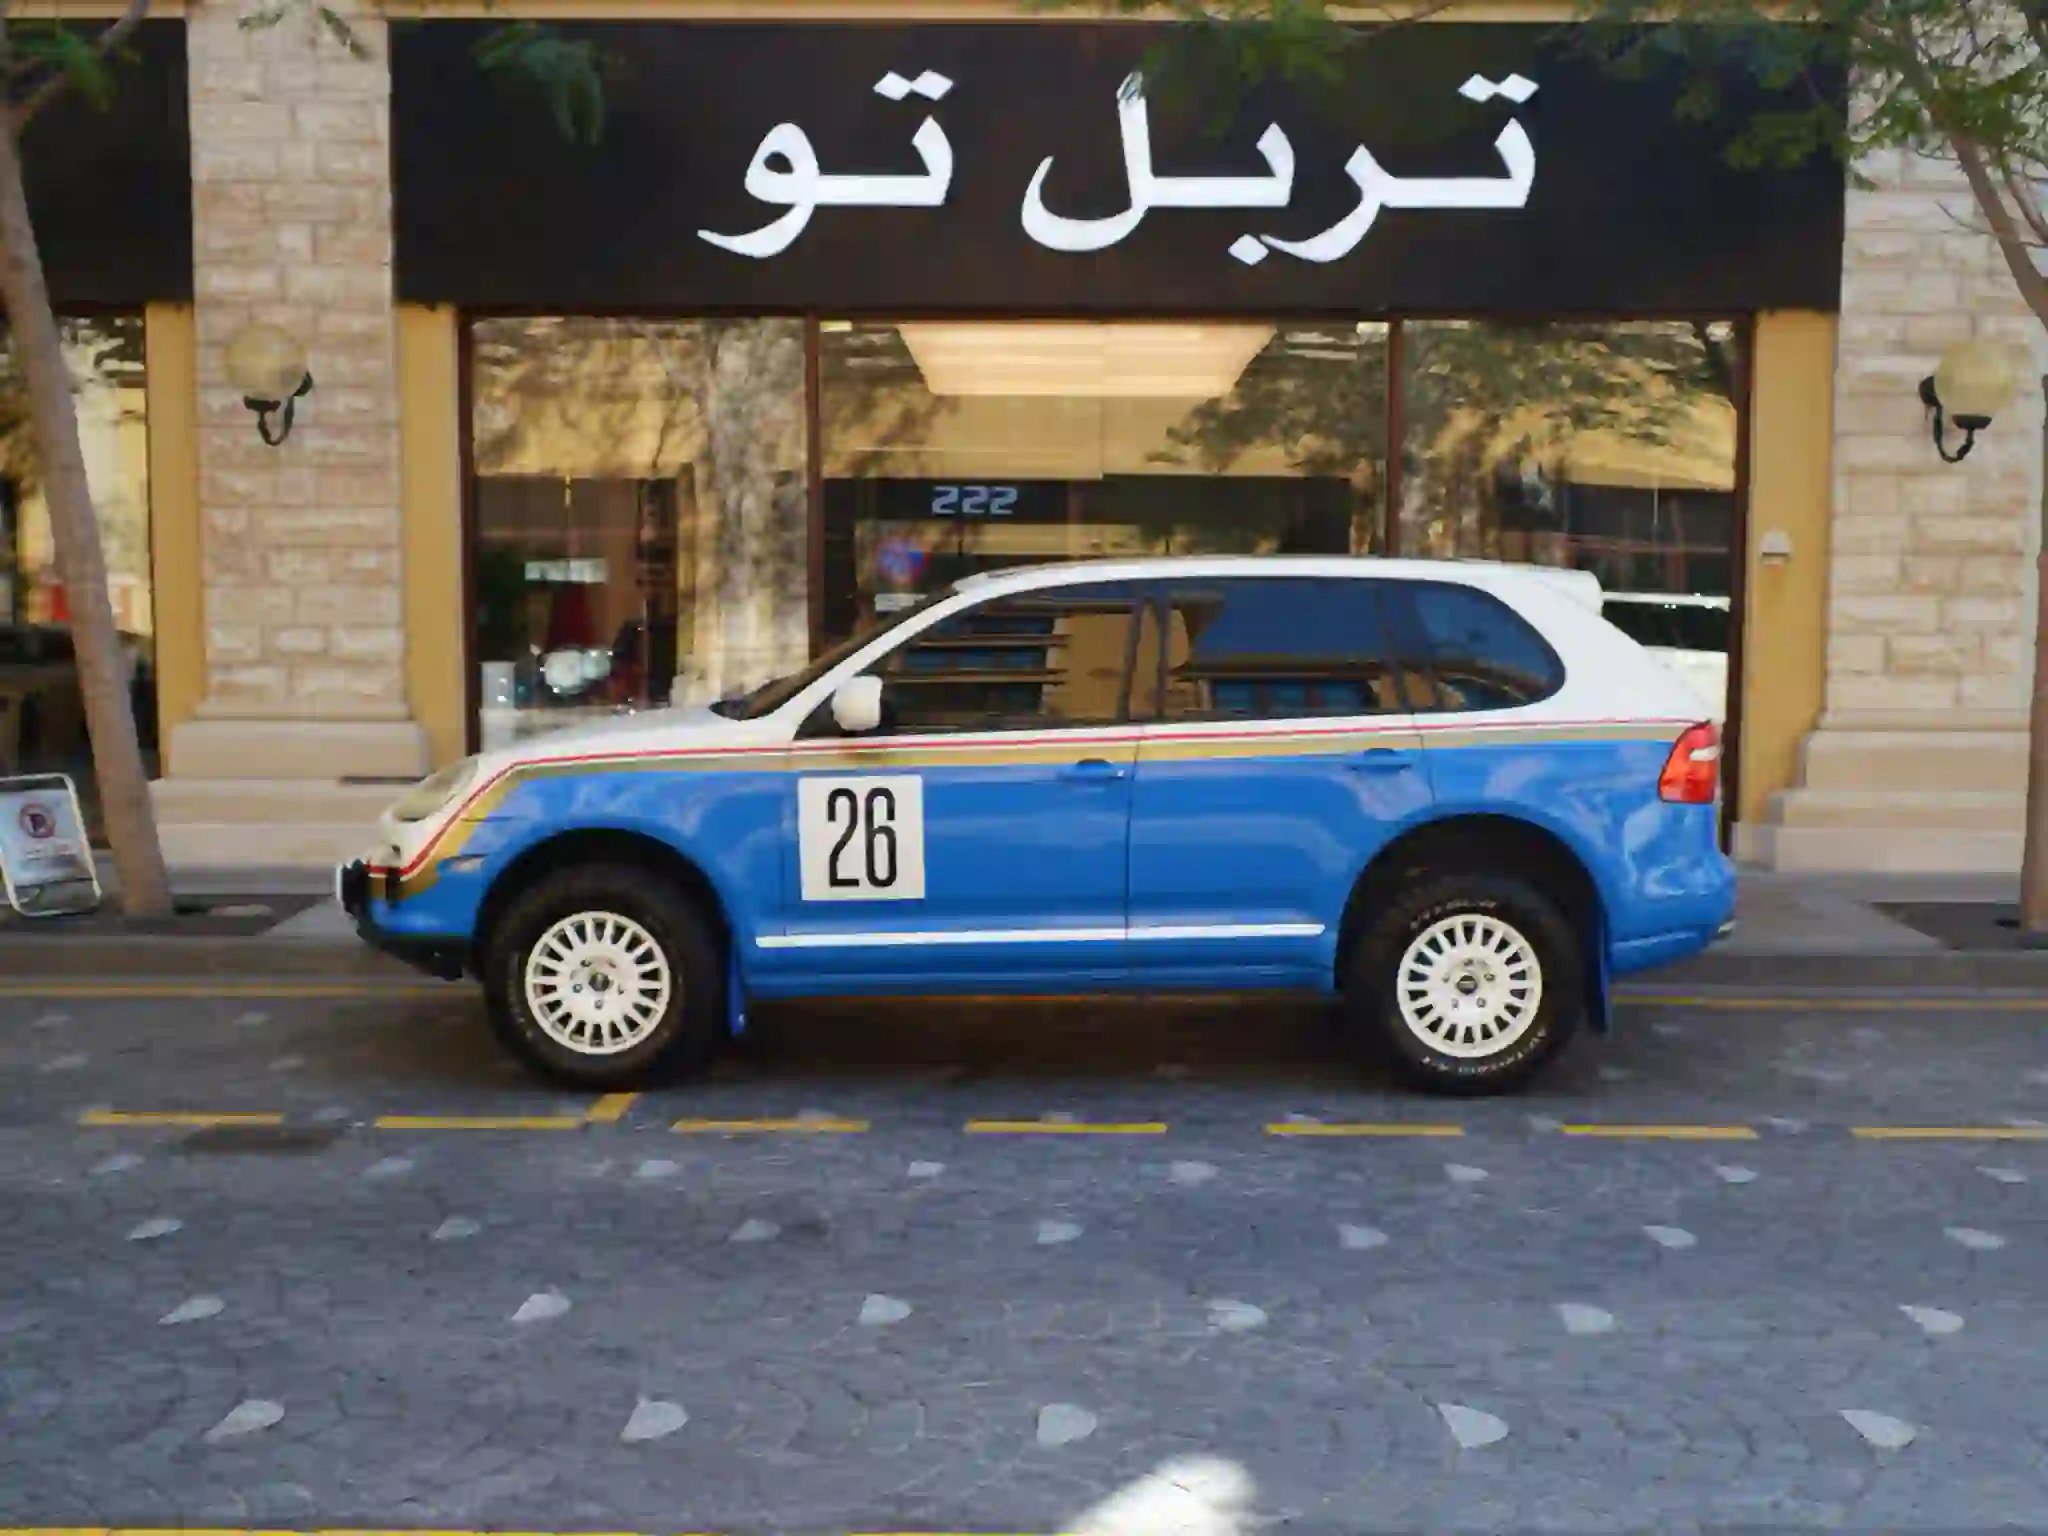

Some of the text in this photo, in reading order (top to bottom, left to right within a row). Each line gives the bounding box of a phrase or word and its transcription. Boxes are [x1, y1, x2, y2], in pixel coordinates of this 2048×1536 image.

[697, 69, 1539, 265] تربل تو
[931, 485, 1018, 514] 222
[827, 787, 897, 888] 26
